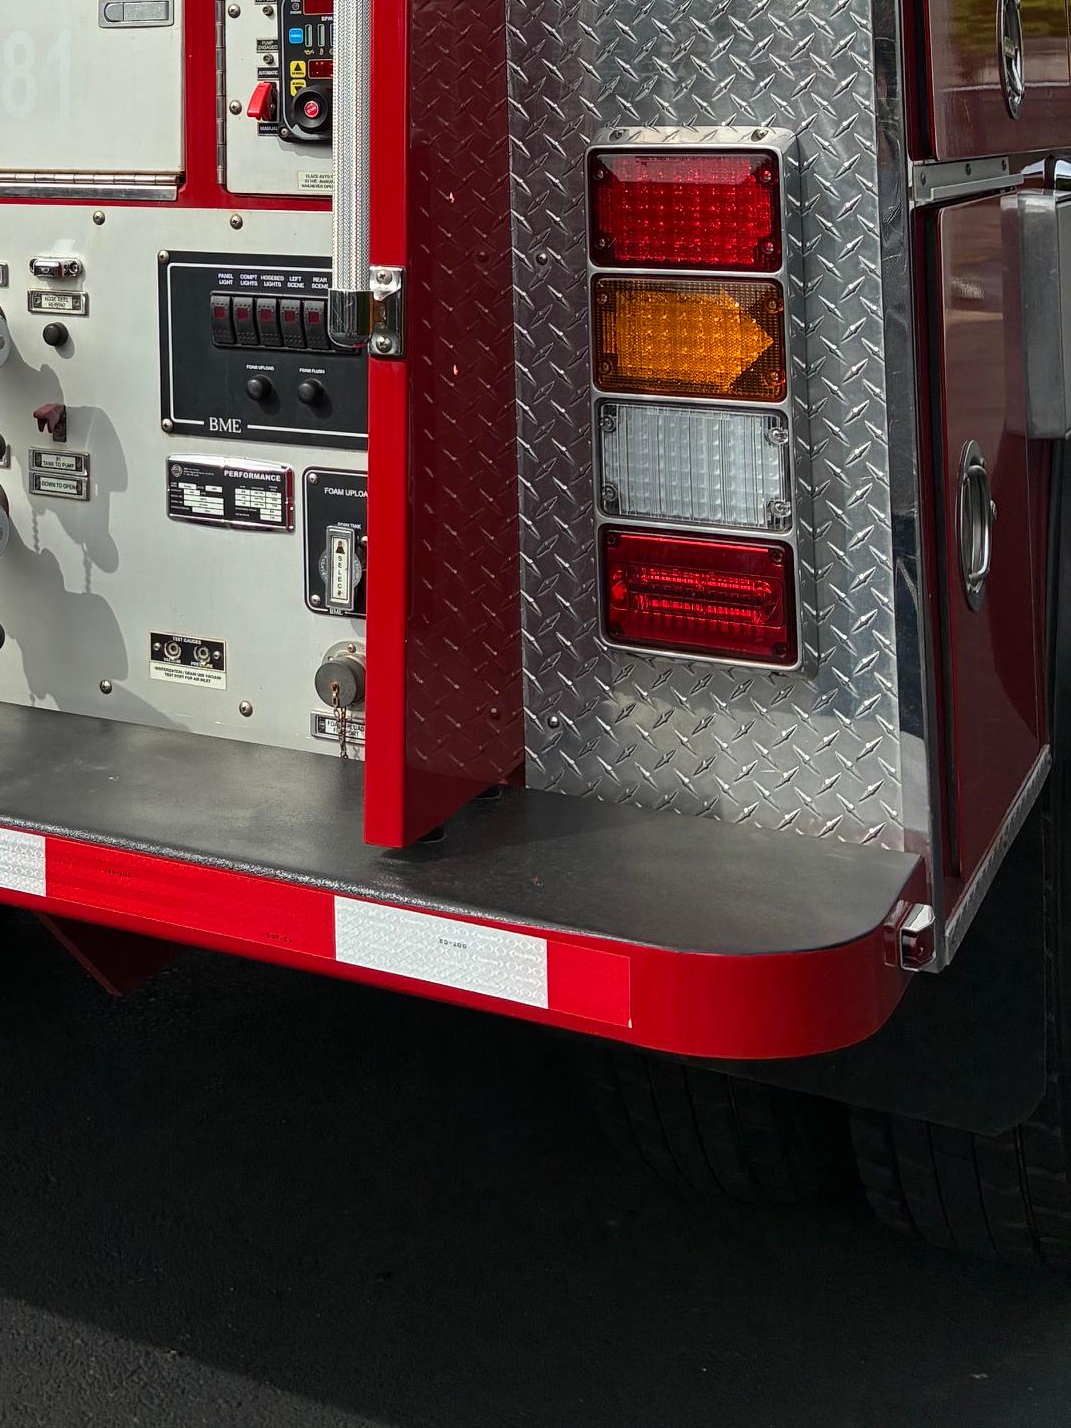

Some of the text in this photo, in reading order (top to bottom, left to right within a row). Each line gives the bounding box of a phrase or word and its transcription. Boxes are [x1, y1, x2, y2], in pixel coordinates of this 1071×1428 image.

[209, 417, 242, 433] BME
[224, 470, 281, 482] PERFORMANCE
[324, 487, 368, 498] FOAM UPLOA
